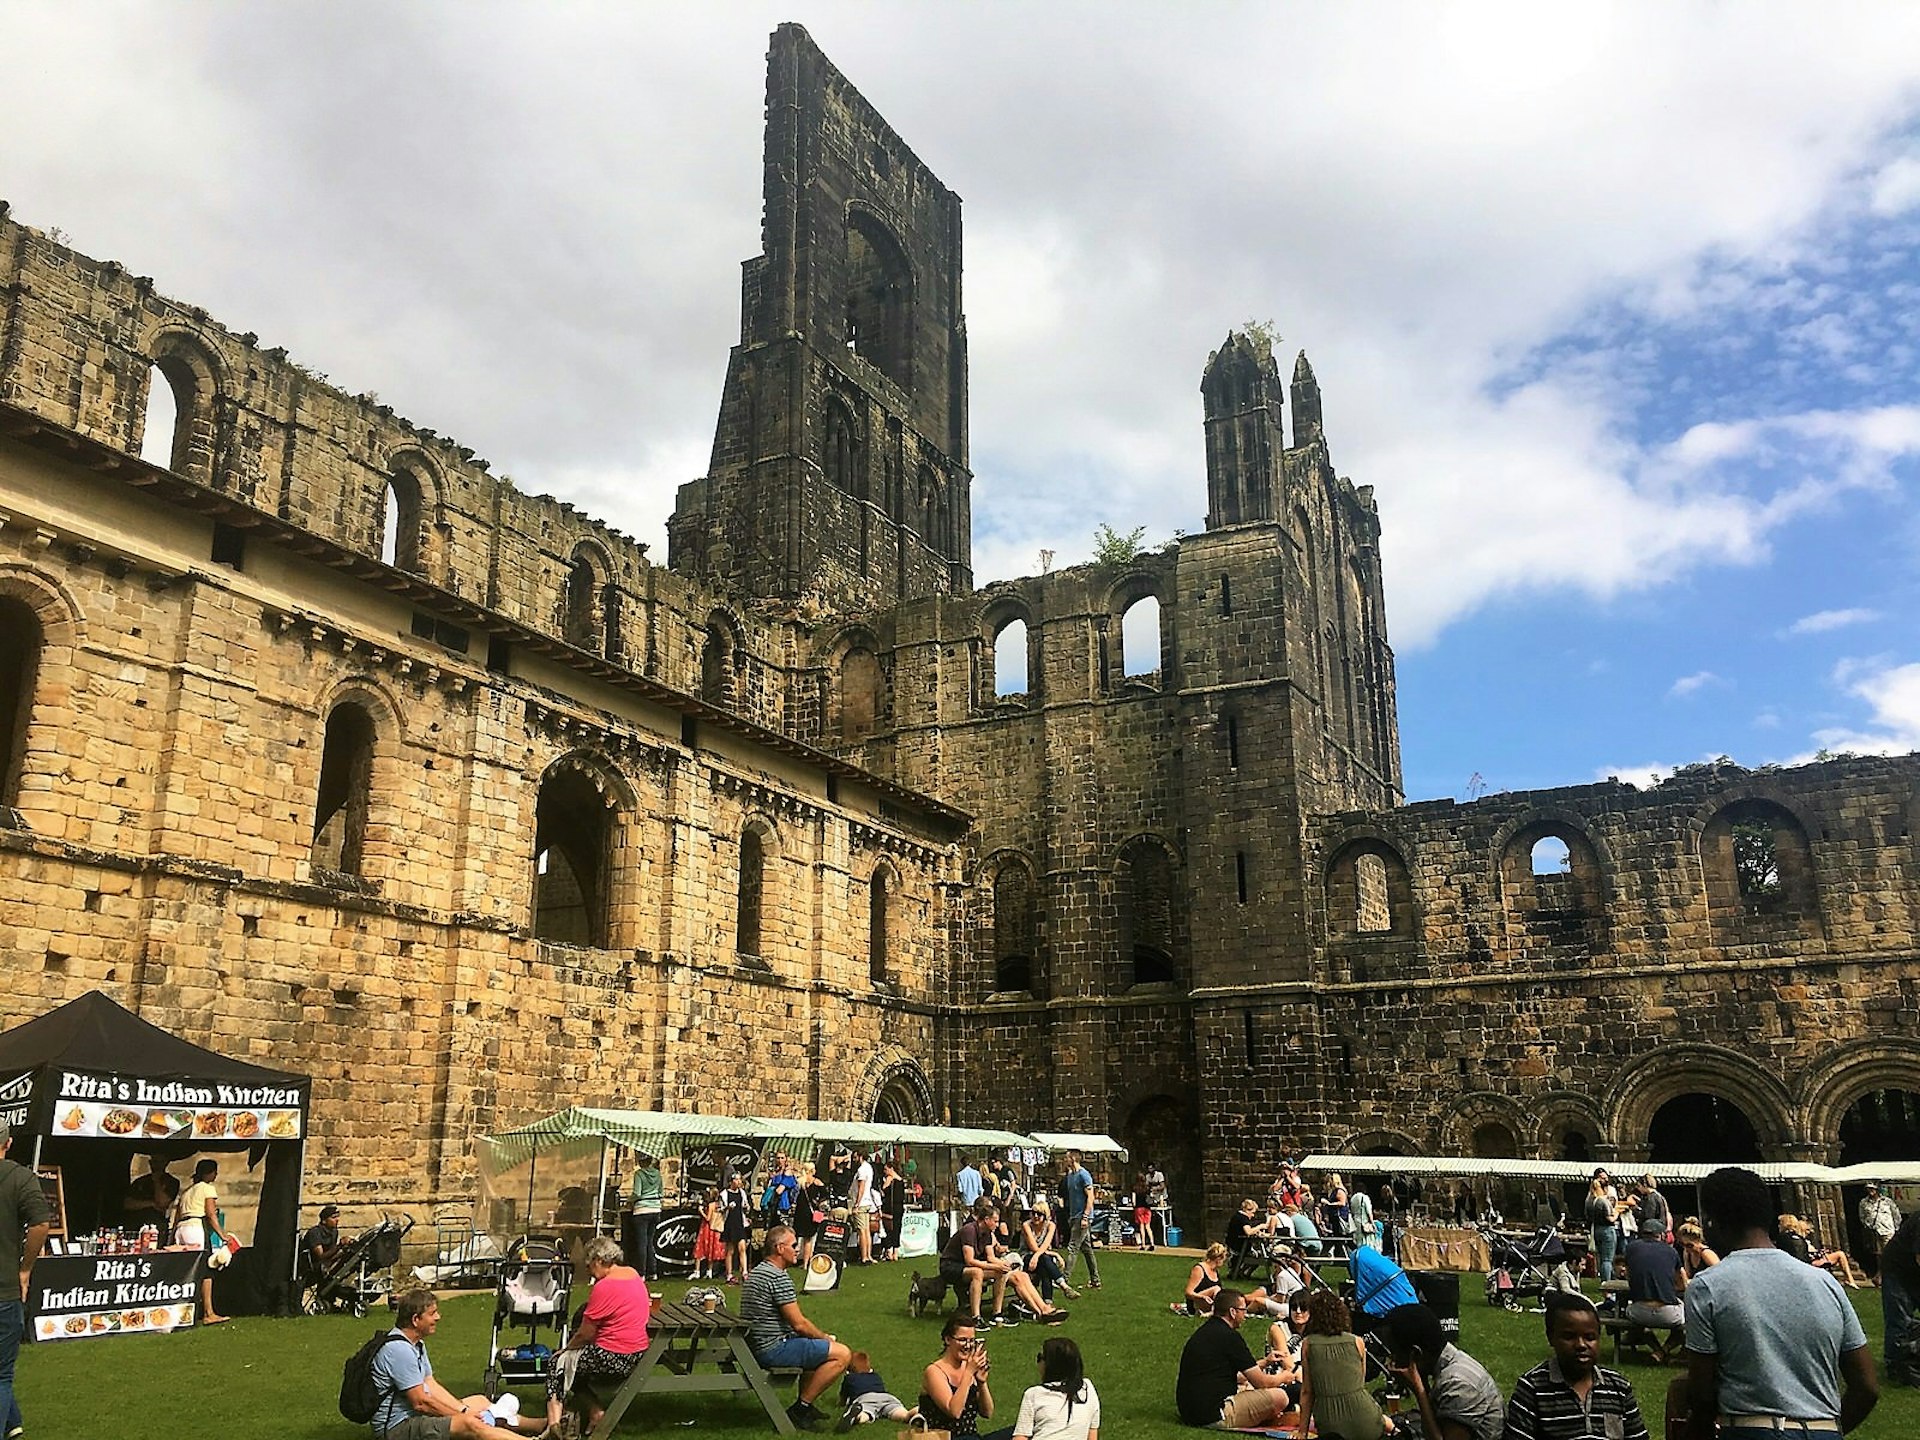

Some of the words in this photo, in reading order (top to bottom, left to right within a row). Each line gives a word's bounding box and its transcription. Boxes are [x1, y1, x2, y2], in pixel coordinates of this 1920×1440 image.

[59, 1072, 130, 1100] Rita's
[136, 1079, 213, 1104] Indian
[216, 1084, 300, 1105] Kitchen
[93, 1258, 152, 1281] Rita's
[41, 1286, 109, 1310] Indian
[113, 1280, 196, 1303] Kitchen
